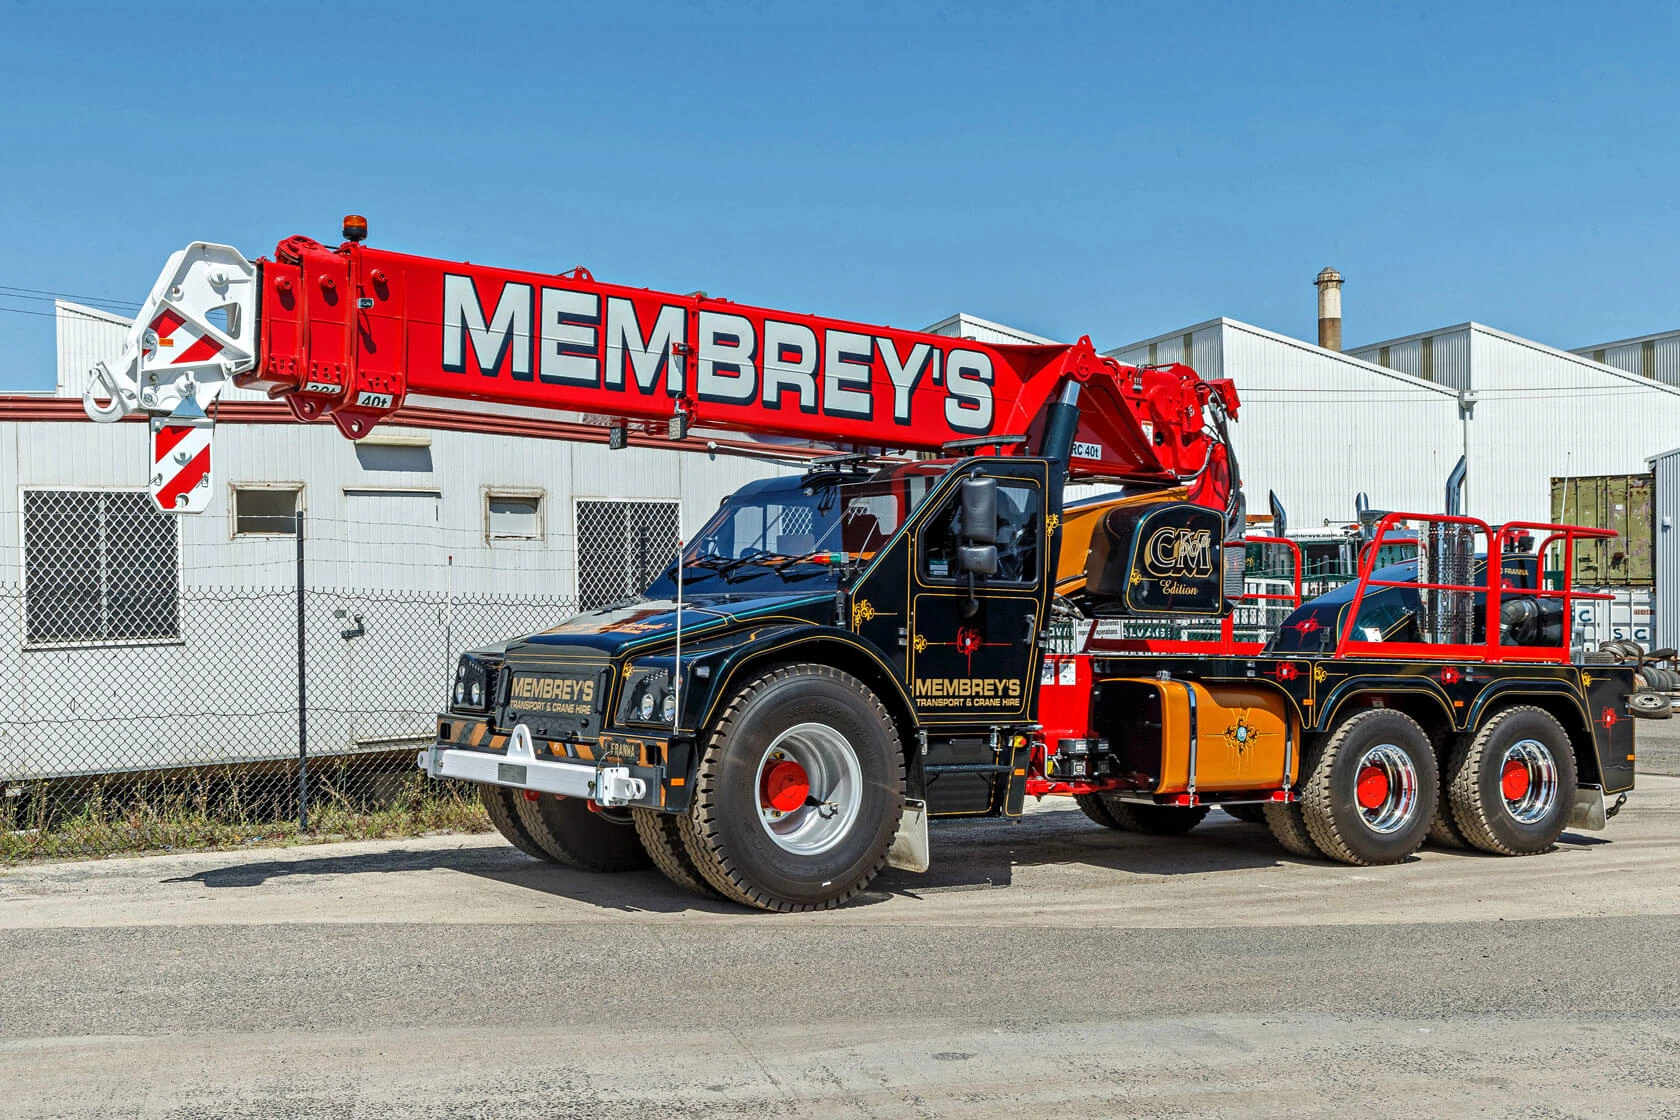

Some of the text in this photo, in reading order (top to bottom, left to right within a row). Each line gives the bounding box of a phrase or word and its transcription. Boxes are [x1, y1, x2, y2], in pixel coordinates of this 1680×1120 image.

[443, 272, 994, 436] MEMBREY'S
[361, 395, 387, 408] 40t
[1085, 445, 1099, 458] 40t
[1146, 527, 1212, 573] CM
[1160, 579, 1199, 595] Edition
[511, 676, 595, 702] MEMBREY'S
[915, 678, 1021, 696] MEMBREY'S
[510, 699, 592, 715] TRANSPORT & CRANE HIRE
[916, 698, 1020, 707] TRANSPORT & CRANE HIRE
[610, 742, 636, 758] FRANNA
